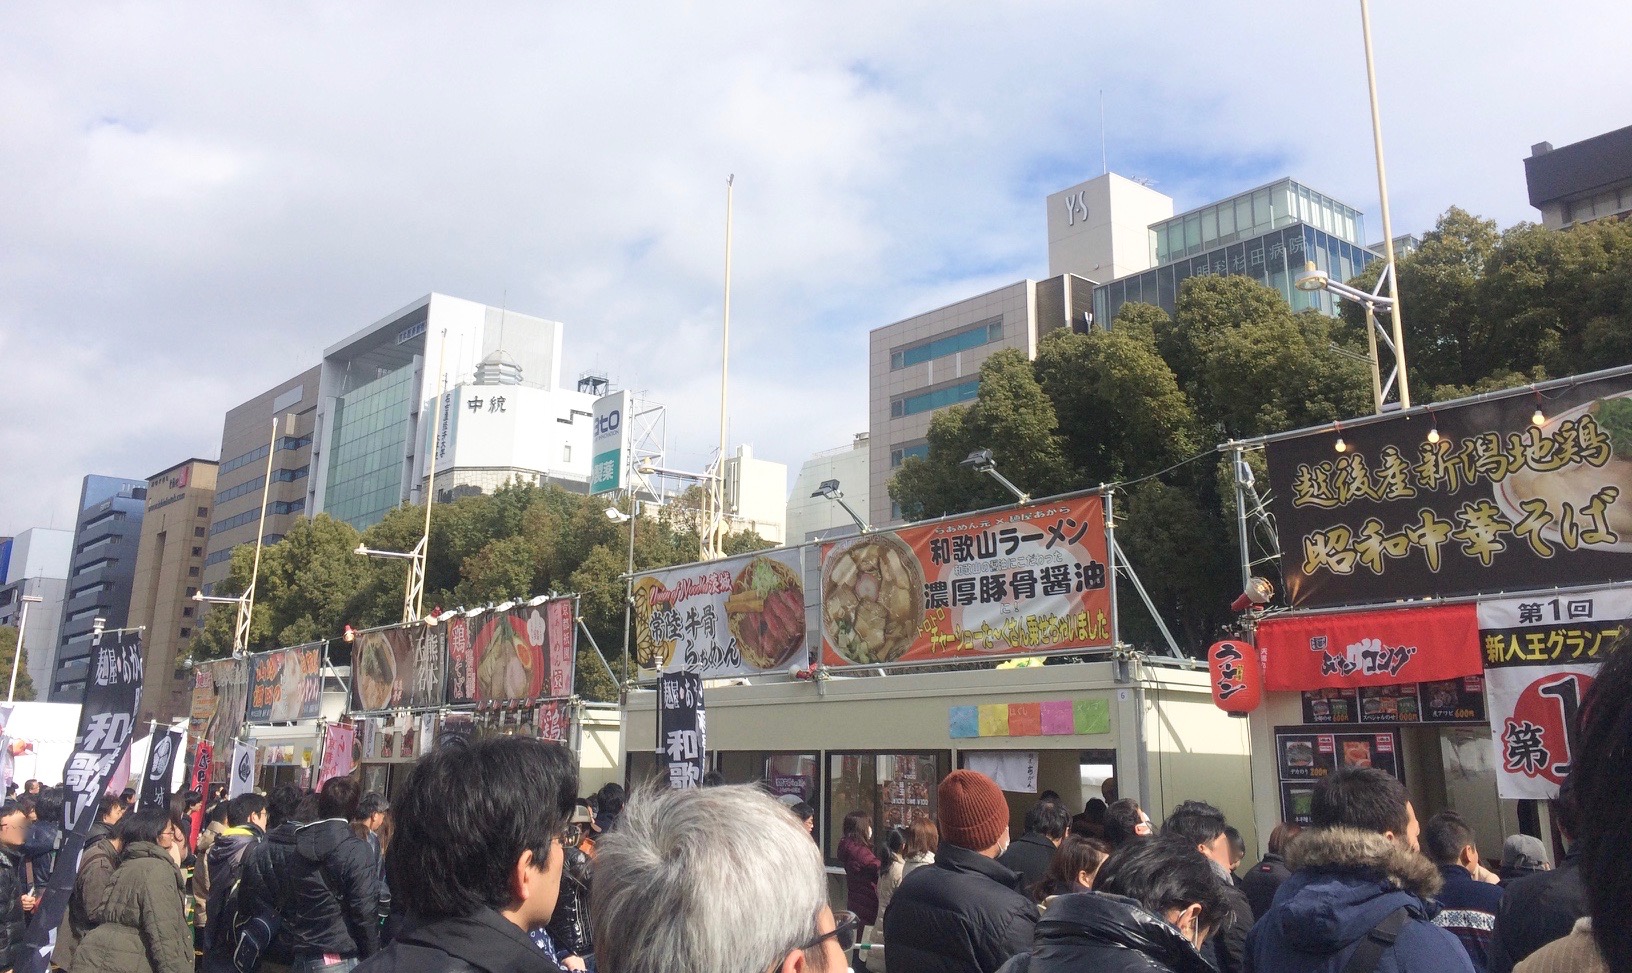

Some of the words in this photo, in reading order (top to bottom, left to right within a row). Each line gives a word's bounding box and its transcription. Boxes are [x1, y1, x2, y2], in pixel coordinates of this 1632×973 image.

[1291, 414, 1613, 508] 越後産新潟地鶏
[929, 517, 1089, 566] 和歌山ラーメン
[1301, 486, 1621, 575] 昭和中華そば
[923, 560, 1106, 610] 濃厚豚骨醤油
[1517, 597, 1594, 625] 第1回
[1214, 642, 1248, 700] ラーメン
